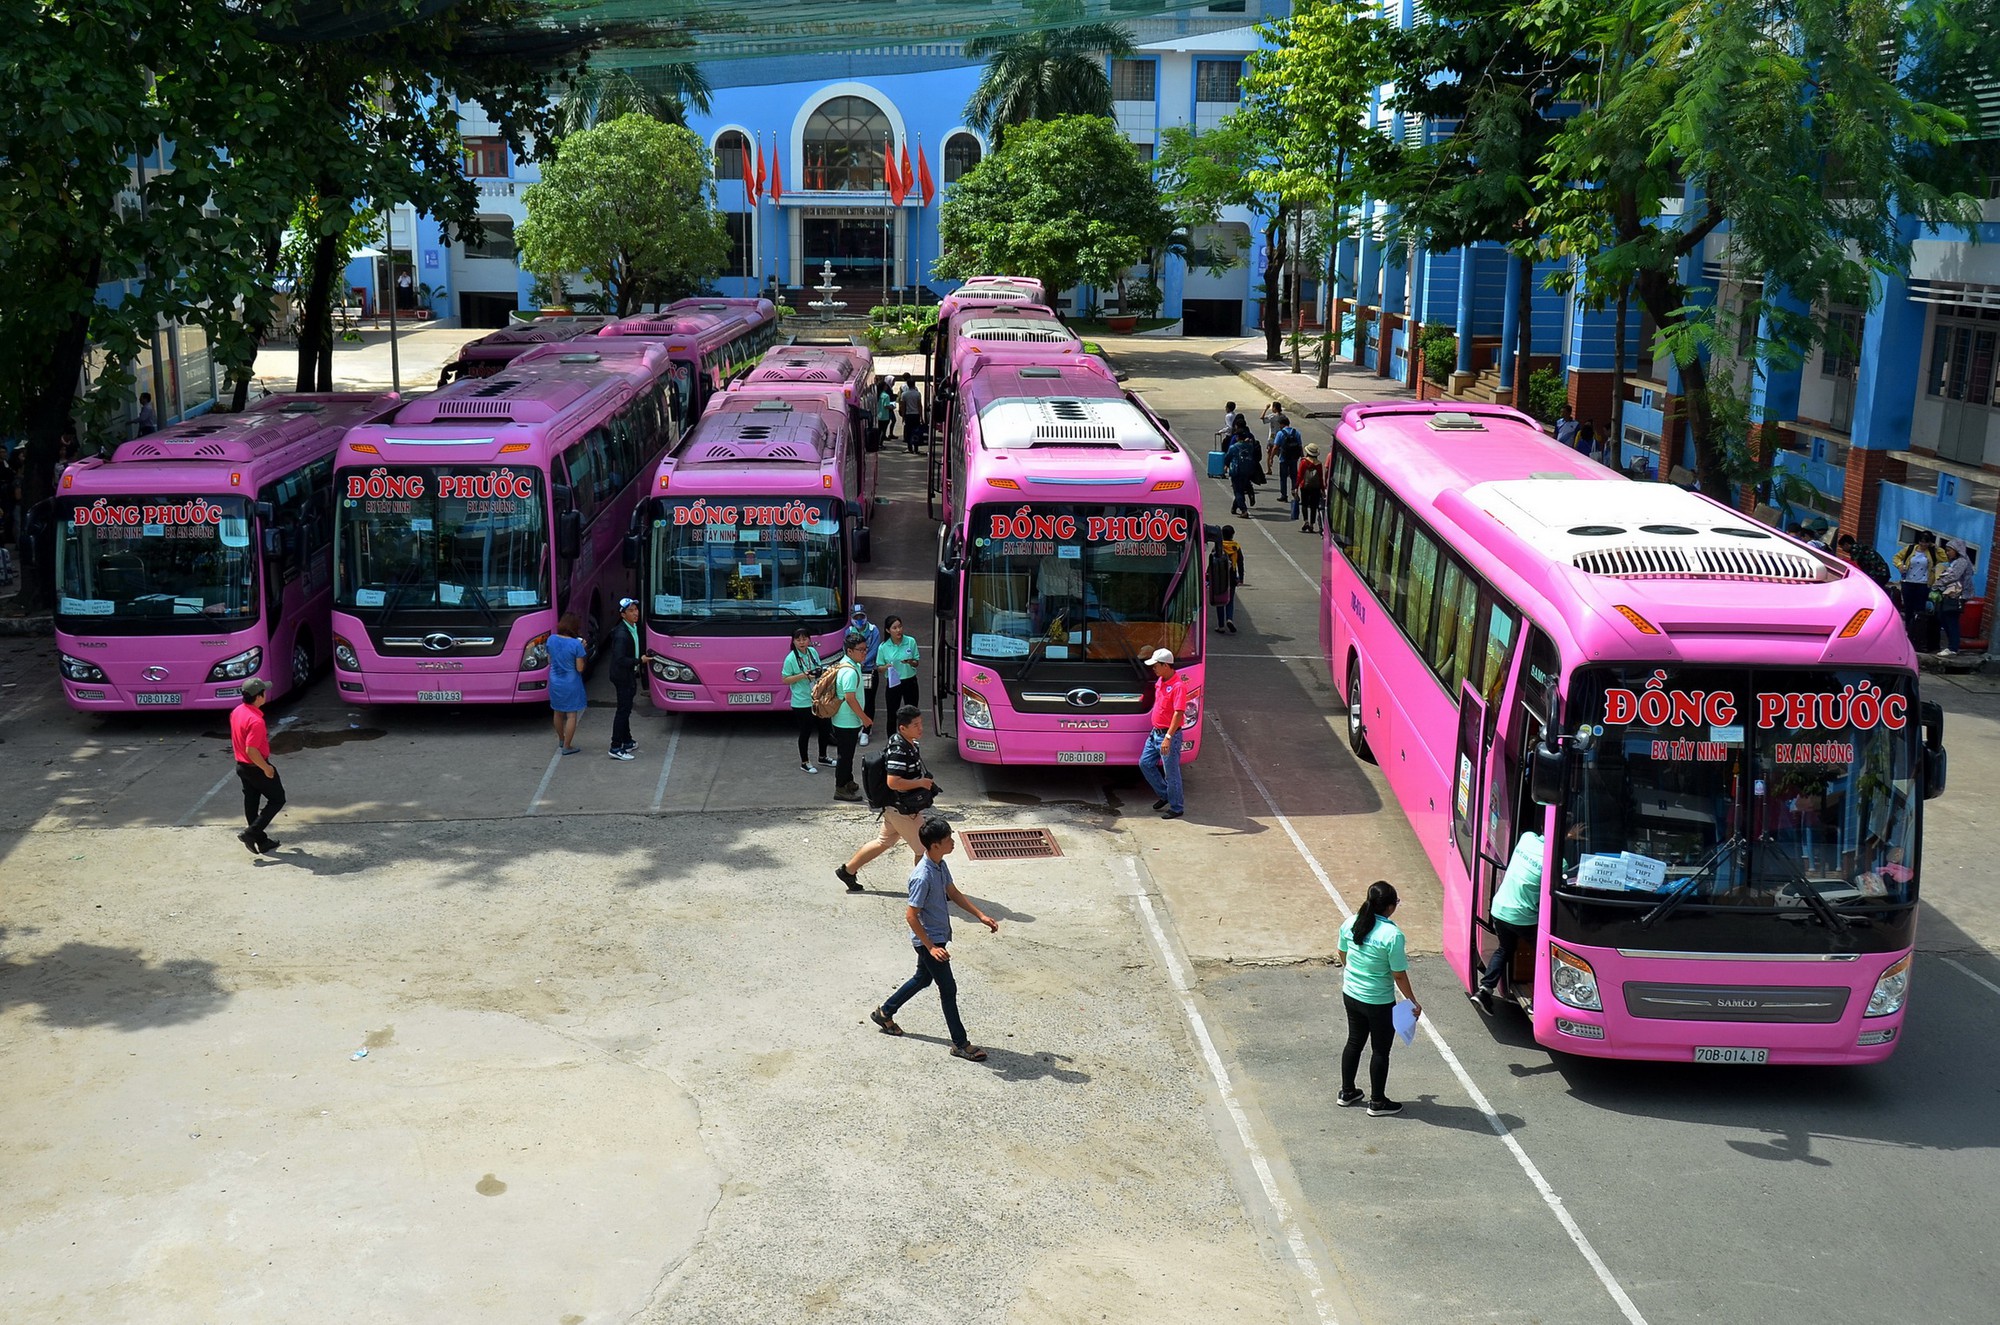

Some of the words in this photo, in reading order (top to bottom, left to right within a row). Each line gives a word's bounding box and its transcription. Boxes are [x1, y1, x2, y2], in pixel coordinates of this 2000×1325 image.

[347, 468, 424, 498] ĐỒNG
[438, 468, 533, 498] PHƯỚC
[74, 498, 140, 525] ĐỒNG
[143, 498, 222, 524] PHƯỚC
[366, 500, 377, 513] BX
[392, 500, 411, 513] NINH
[467, 500, 478, 513] BX
[478, 500, 489, 513] AN
[673, 498, 738, 525] ĐỒNG
[743, 500, 820, 525] PHƯỚC
[990, 505, 1076, 539] ĐỒNG
[1087, 508, 1188, 542] PHƯỚC
[96, 526, 107, 539] BX
[124, 526, 143, 539] NINH
[165, 526, 176, 538] BX
[177, 526, 188, 538] AN
[692, 529, 702, 541] BX
[719, 529, 738, 541] NINH
[761, 529, 771, 541] BX
[773, 529, 783, 541] AN
[1003, 542, 1014, 555] BX
[1034, 542, 1054, 555] NINH
[1115, 542, 1126, 556] BX
[1127, 542, 1139, 556] AN
[1530, 664, 1548, 685] SAMC
[1603, 669, 1737, 727] ĐỒNG
[1757, 680, 1907, 730] PHƯỚC
[1057, 719, 1109, 729] THACO
[1651, 740, 1668, 760] BX
[1670, 737, 1695, 761] TÂY
[1697, 741, 1727, 762] NINH
[1775, 743, 1792, 763] BX
[1793, 744, 1811, 763] AN
[1813, 740, 1854, 764] SƯƠNG
[1059, 753, 1104, 762] 70B-010.88
[1635, 869, 1651, 877] THPT
[1717, 998, 1757, 1007] SAMCO
[1697, 1049, 1765, 1062] 70B-014.18
